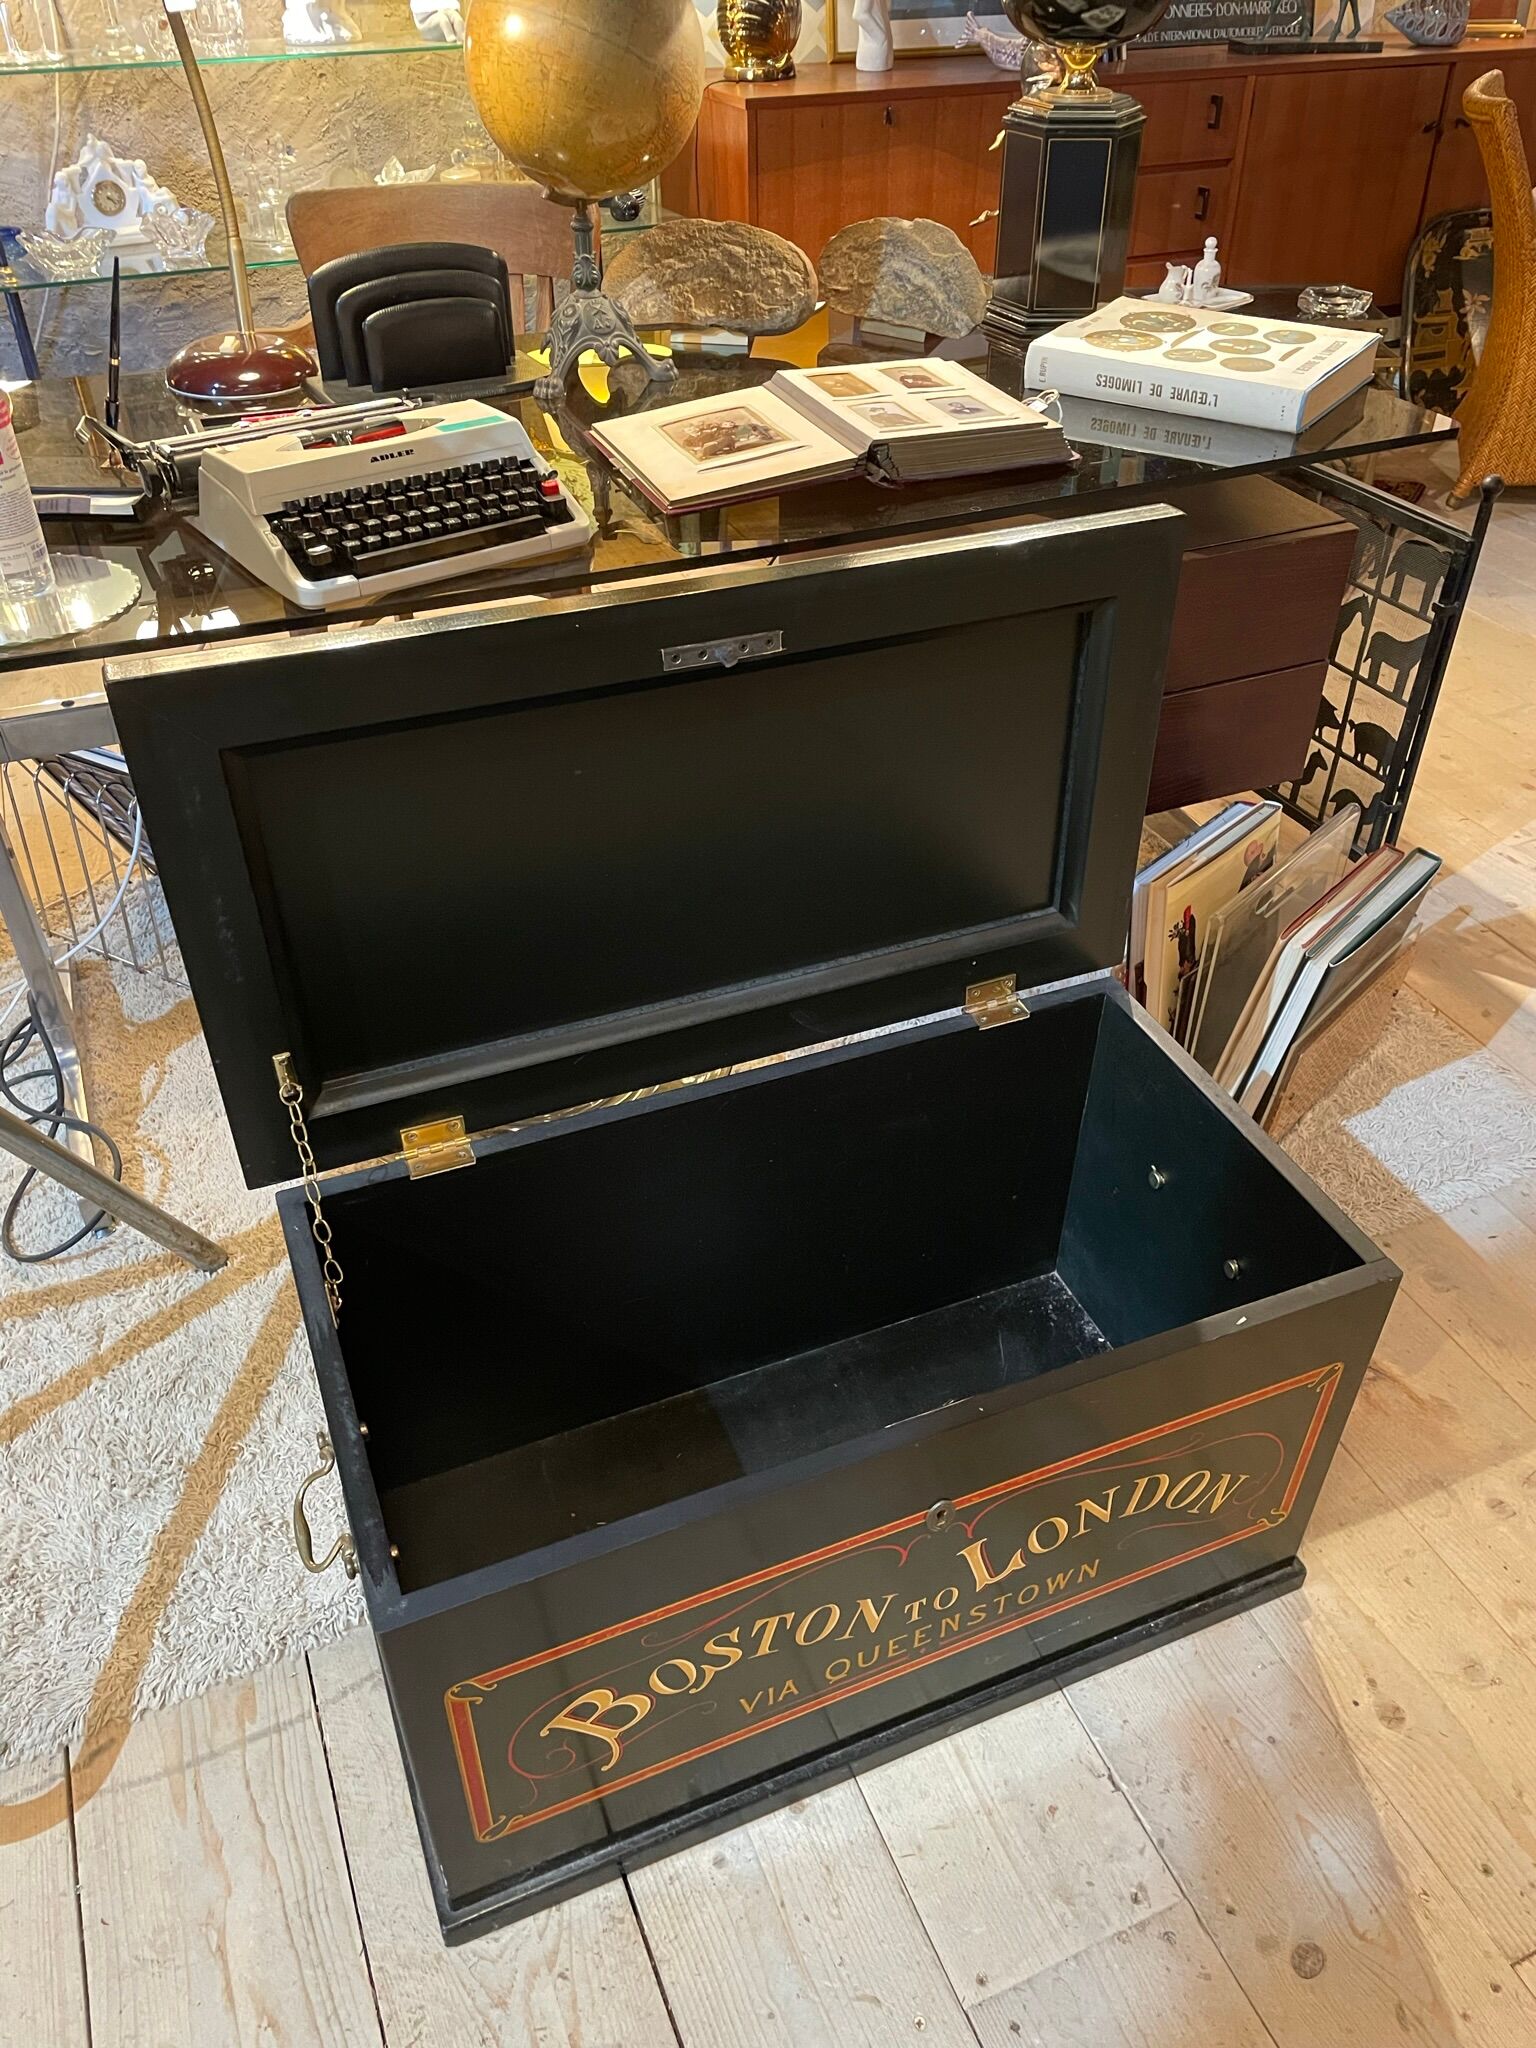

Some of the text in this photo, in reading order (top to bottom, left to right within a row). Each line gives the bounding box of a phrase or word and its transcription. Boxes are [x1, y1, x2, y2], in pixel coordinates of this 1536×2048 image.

[1160, 28, 1213, 42] INTERNATIONAL
[1095, 374, 1143, 394] LIMOGES
[1149, 383, 1163, 398] DE
[370, 449, 415, 463] ADLER
[539, 1470, 1250, 1772] BOSTON TO LONDON
[739, 1559, 1100, 1715] VIA QUEENSTOWN
